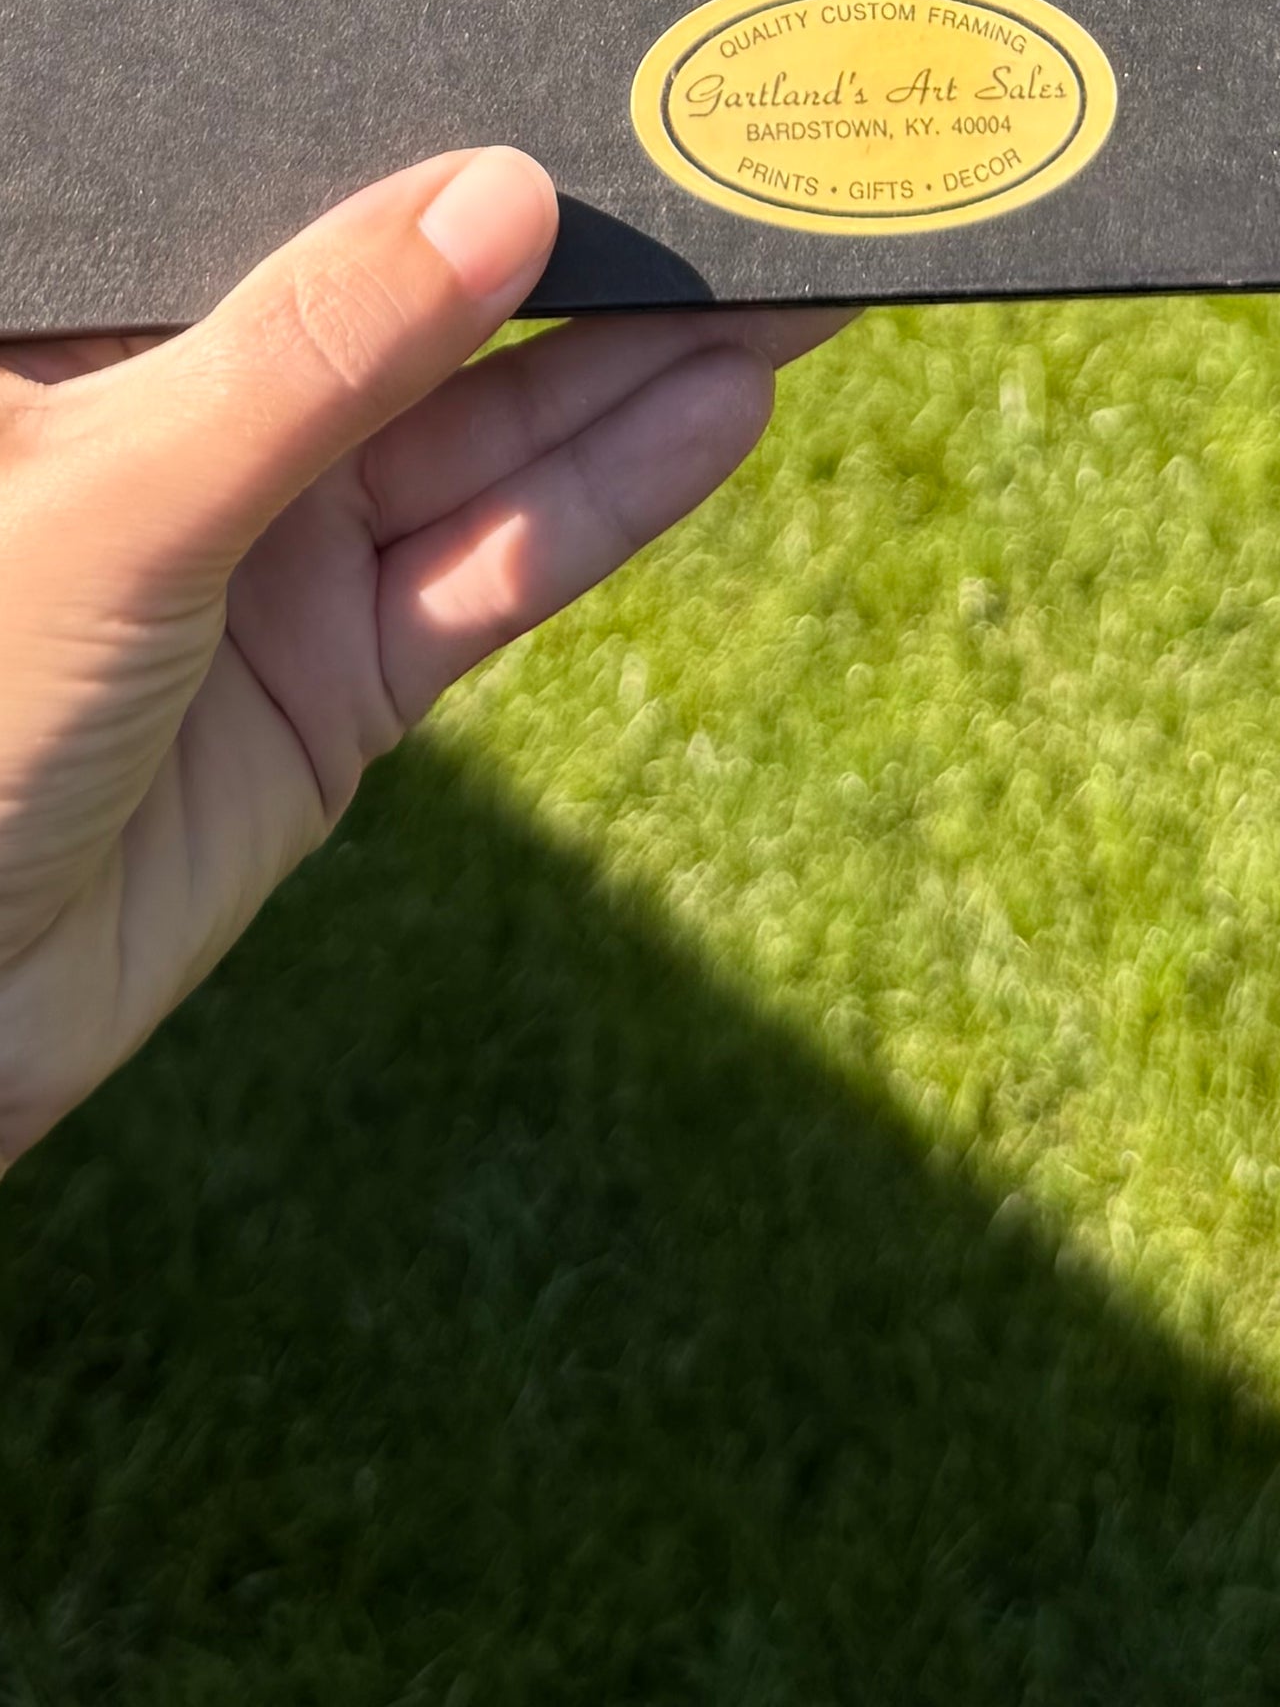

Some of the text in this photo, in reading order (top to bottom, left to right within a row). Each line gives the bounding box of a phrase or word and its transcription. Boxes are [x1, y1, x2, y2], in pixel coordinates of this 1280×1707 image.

[720, 2, 1027, 59] QUALITY CUSTOM FRAMING
[686, 65, 1068, 118] Gartland's Art Sales
[746, 114, 1012, 141] BARDSTOWN, KY. 40004
[737, 147, 1022, 200] PRINTS GIFTS DECOR
